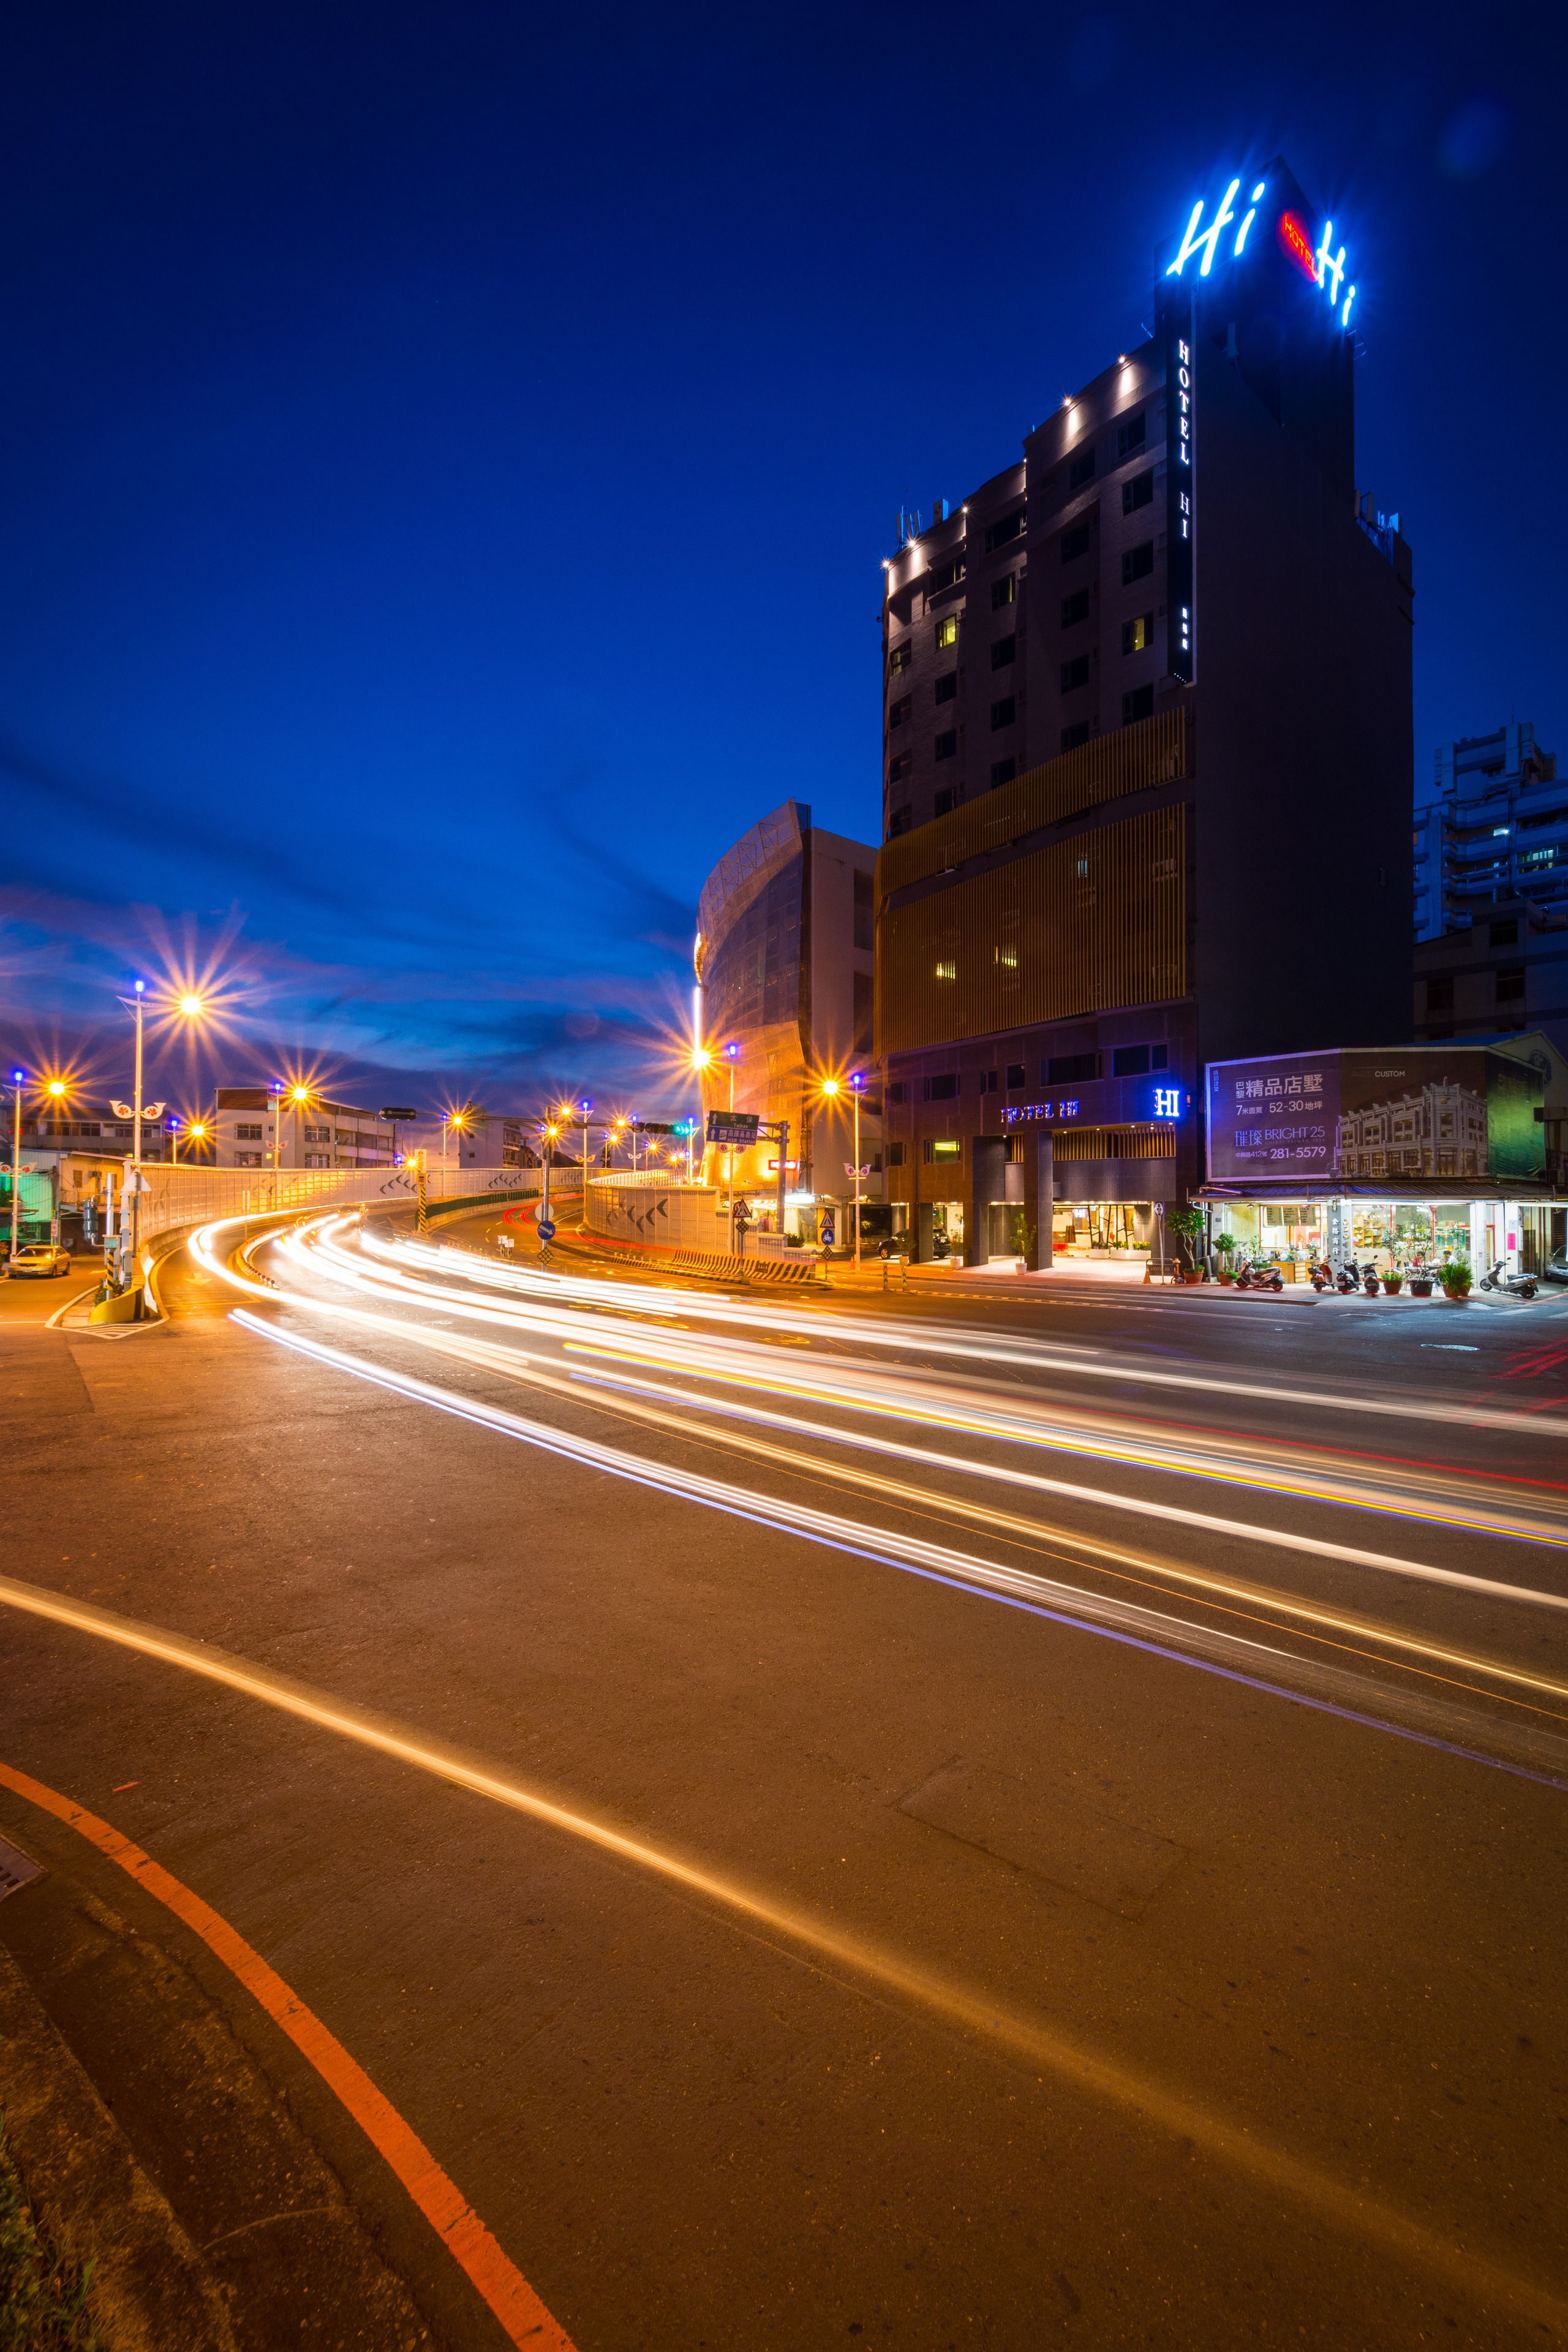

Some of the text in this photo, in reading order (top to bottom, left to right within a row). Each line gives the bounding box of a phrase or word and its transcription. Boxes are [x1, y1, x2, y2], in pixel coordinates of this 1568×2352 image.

[1166, 178, 1265, 277] Hi
[1284, 212, 1355, 326] HOTEL Hi
[1178, 339, 1190, 538] HOTEL HI
[1245, 1074, 1323, 1098] 精品店墅
[1000, 1100, 1080, 1123] HOTEL HI
[1155, 1088, 1180, 1117] HI
[1265, 1126, 1309, 1140] BRIGHT
[1310, 1126, 1325, 1138] 25
[1270, 1146, 1327, 1159] 281-5579
